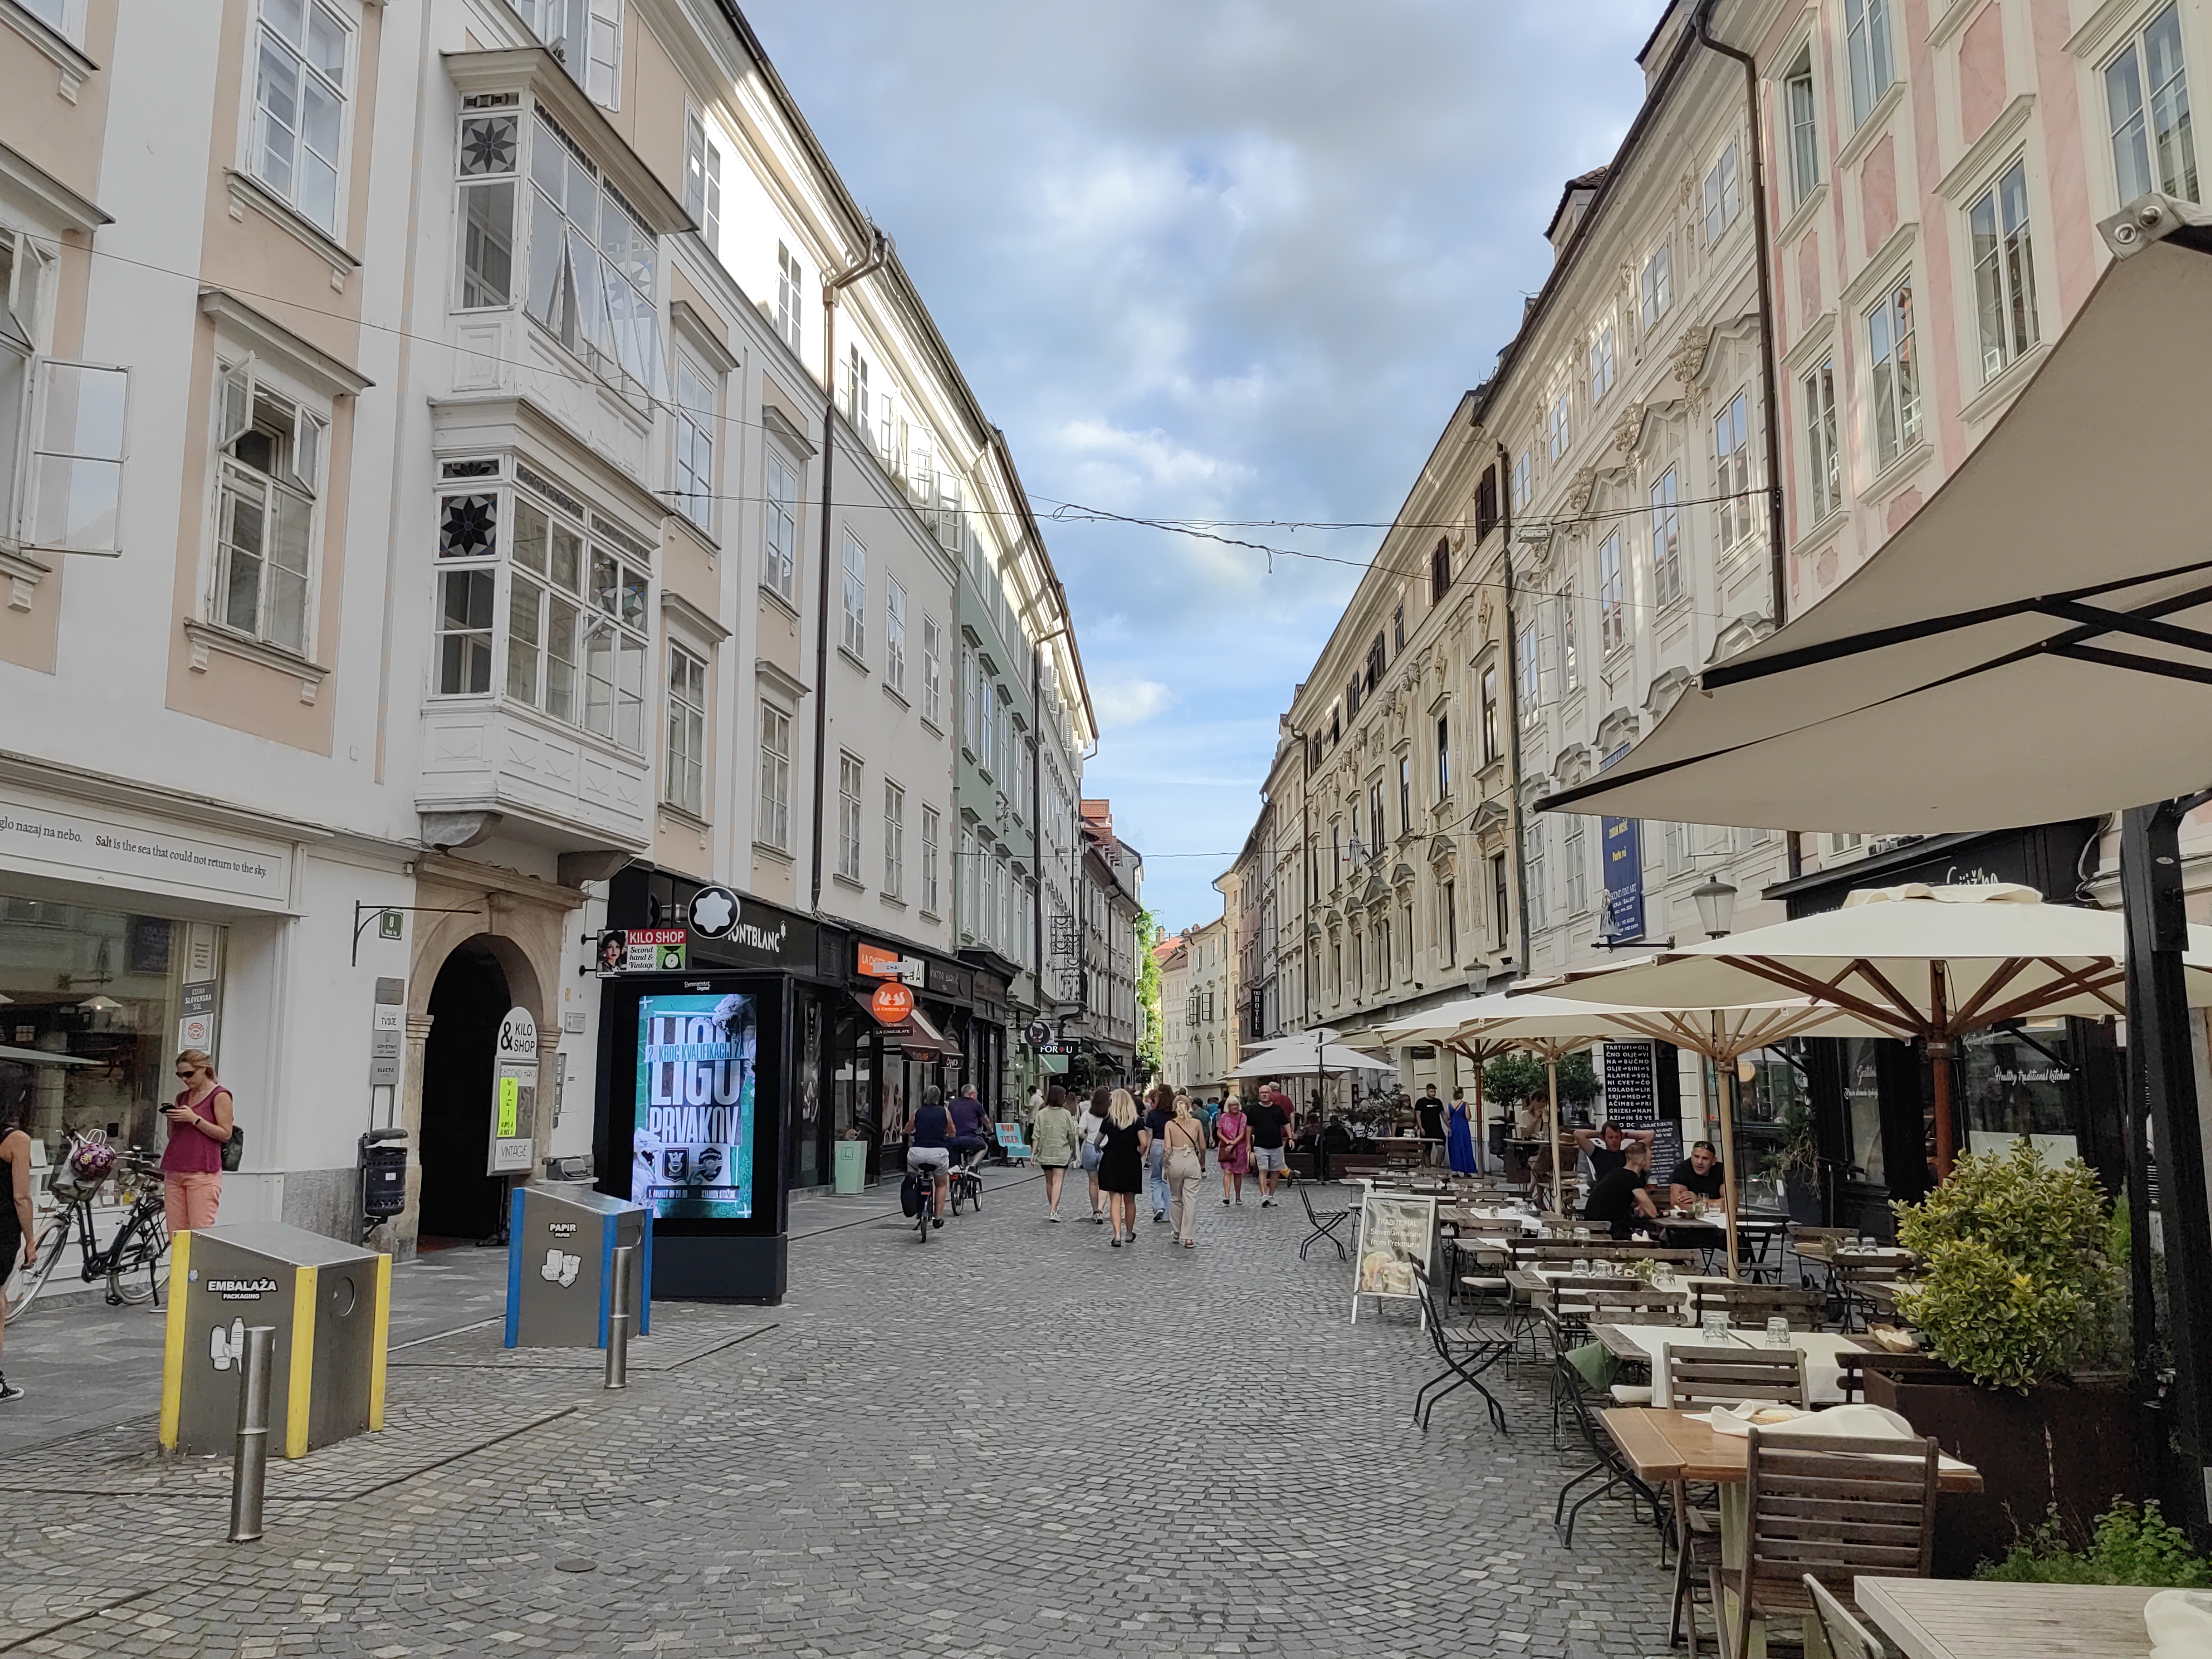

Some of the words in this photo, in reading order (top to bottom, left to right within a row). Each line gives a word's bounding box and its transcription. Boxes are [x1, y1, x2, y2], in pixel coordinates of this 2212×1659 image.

[16, 822, 42, 838] nazaj
[43, 827, 55, 837] na
[57, 828, 82, 842] nebo.
[96, 835, 112, 847] Salt
[113, 838, 120, 849] is
[123, 839, 136, 852] the
[138, 845, 151, 854] sea
[153, 845, 168, 858] that
[170, 851, 192, 862] could
[193, 855, 207, 865] not
[208, 858, 231, 869] return
[233, 862, 240, 871] to
[242, 862, 253, 873] the
[254, 865, 267, 878] sky.
[389, 916, 394, 928] 8
[630, 932, 653, 943] KILO
[656, 931, 684, 943] SHOP
[722, 923, 780, 953] ONTBLANC
[629, 961, 654, 970] Vintage
[185, 994, 212, 1004] SLOVENSKA
[515, 1022, 532, 1036] KILO
[501, 1021, 512, 1051] &
[514, 1039, 535, 1053] SHOP
[649, 1047, 657, 1062] 2.
[659, 1046, 679, 1062] KROG
[682, 1043, 732, 1061] KVALIFIKACIJ
[734, 1042, 745, 1058] ZA
[1040, 1045, 1058, 1053] FOR
[500, 1069, 522, 1078] SECOND
[1994, 1065, 2017, 1086] Healthy
[2018, 1068, 2049, 1085] traditional
[2049, 1068, 2071, 1083] kitchen
[649, 1106, 739, 1145] PRVAKOV
[1000, 1135, 1020, 1143] TIGER
[501, 1145, 527, 1157] VINTAGE
[1377, 1218, 1418, 1227] TRADITIONAL
[1370, 1228, 1399, 1236] Slovenian
[1387, 1239, 1420, 1249] Prekmurje
[208, 1278, 277, 1291] EMBALAŽA
